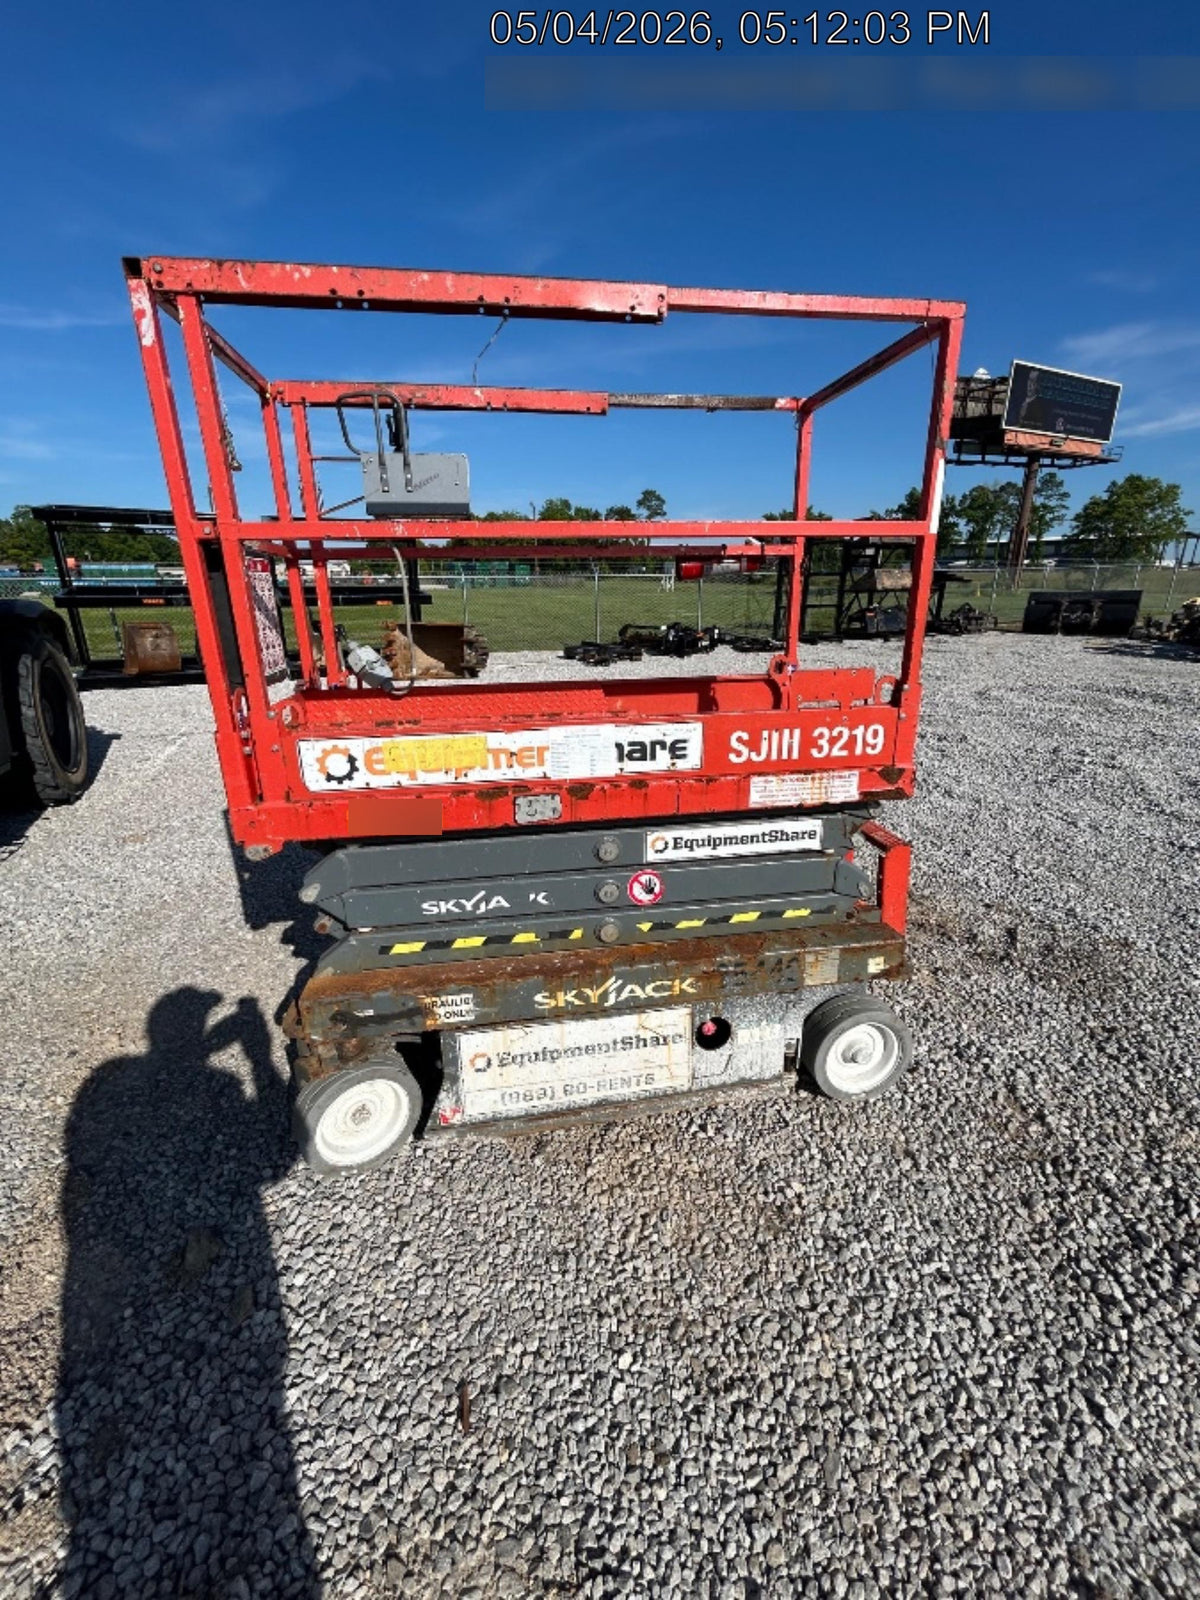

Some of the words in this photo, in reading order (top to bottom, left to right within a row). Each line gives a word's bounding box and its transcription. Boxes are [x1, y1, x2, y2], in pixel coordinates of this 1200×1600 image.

[809, 723, 885, 759] 3219
[671, 828, 818, 850] EquipmentShare
[421, 890, 549, 915] SKYJAK
[533, 975, 698, 1009] SKYJACK
